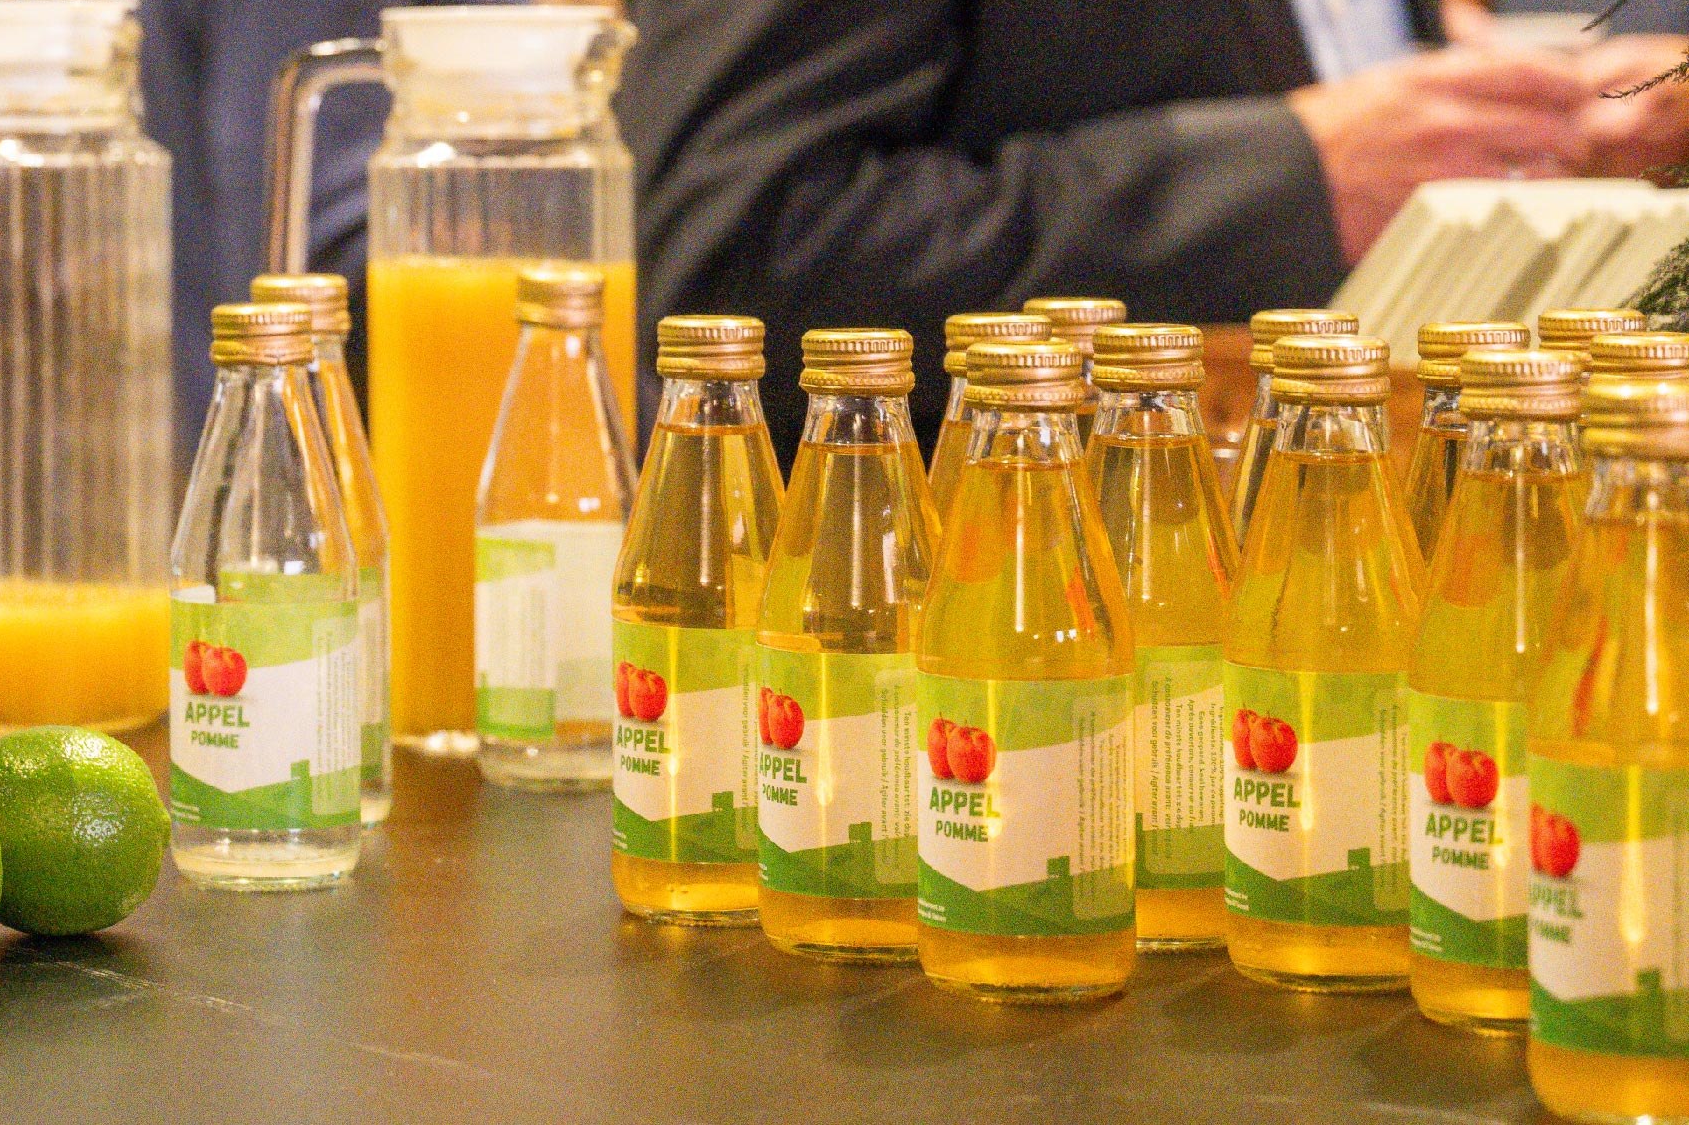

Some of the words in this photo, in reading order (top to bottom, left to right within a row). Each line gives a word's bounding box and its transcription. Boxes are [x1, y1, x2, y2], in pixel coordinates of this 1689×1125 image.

[184, 701, 250, 728] APPEL
[191, 730, 240, 750] POMME
[616, 724, 672, 755] APPEL
[620, 754, 661, 777] POMME
[759, 751, 808, 784] APPEL
[929, 786, 1001, 818] APPEL
[1233, 776, 1301, 809] APPEL
[935, 820, 989, 843] POMME
[1239, 809, 1290, 832] POMME
[1424, 811, 1504, 845] APPEL
[1431, 845, 1490, 871] POMME
